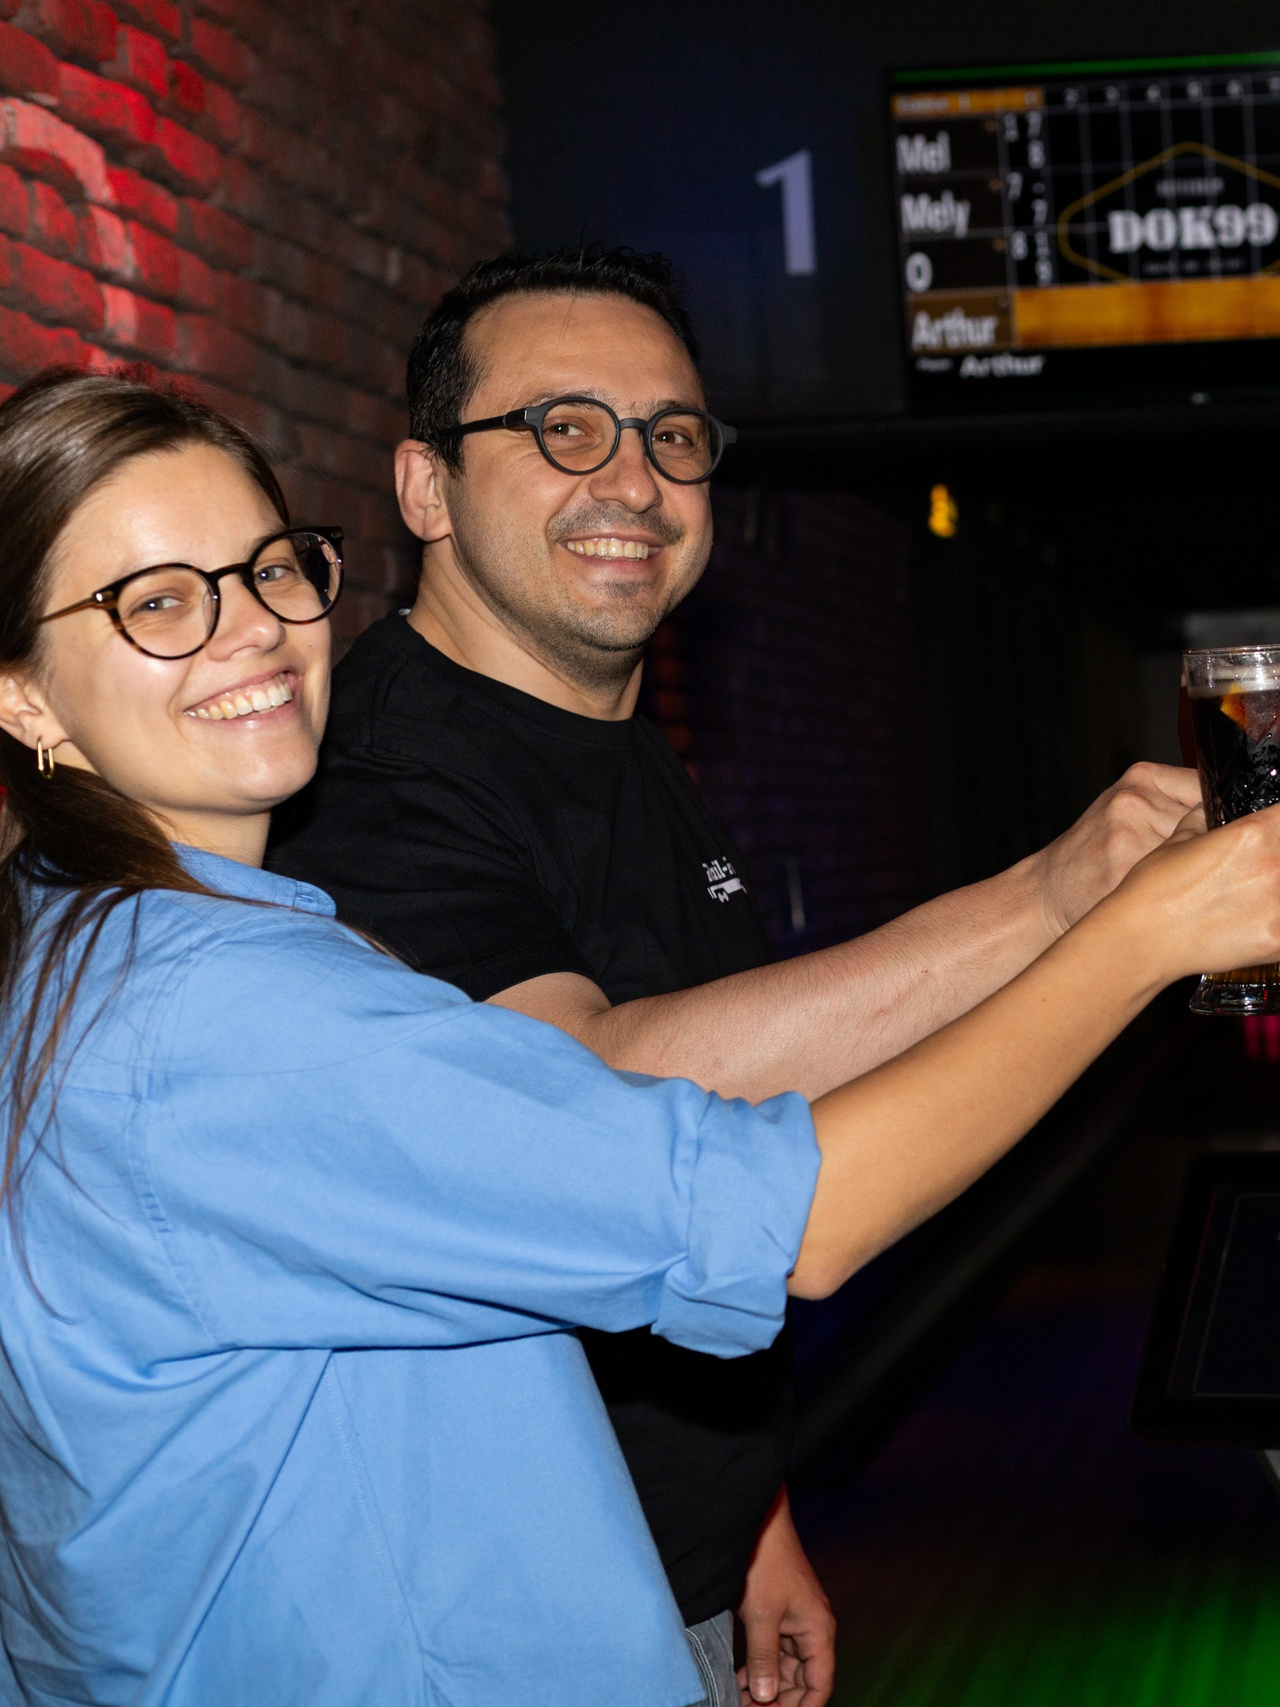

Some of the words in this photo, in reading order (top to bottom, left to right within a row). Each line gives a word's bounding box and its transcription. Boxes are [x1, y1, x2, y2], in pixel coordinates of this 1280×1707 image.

[897, 132, 950, 173] Mel
[753, 148, 818, 276] 1
[901, 189, 971, 238] Mely
[1108, 202, 1278, 254] DOK99
[912, 306, 999, 350] Arthur
[959, 352, 1045, 378] Arthur
